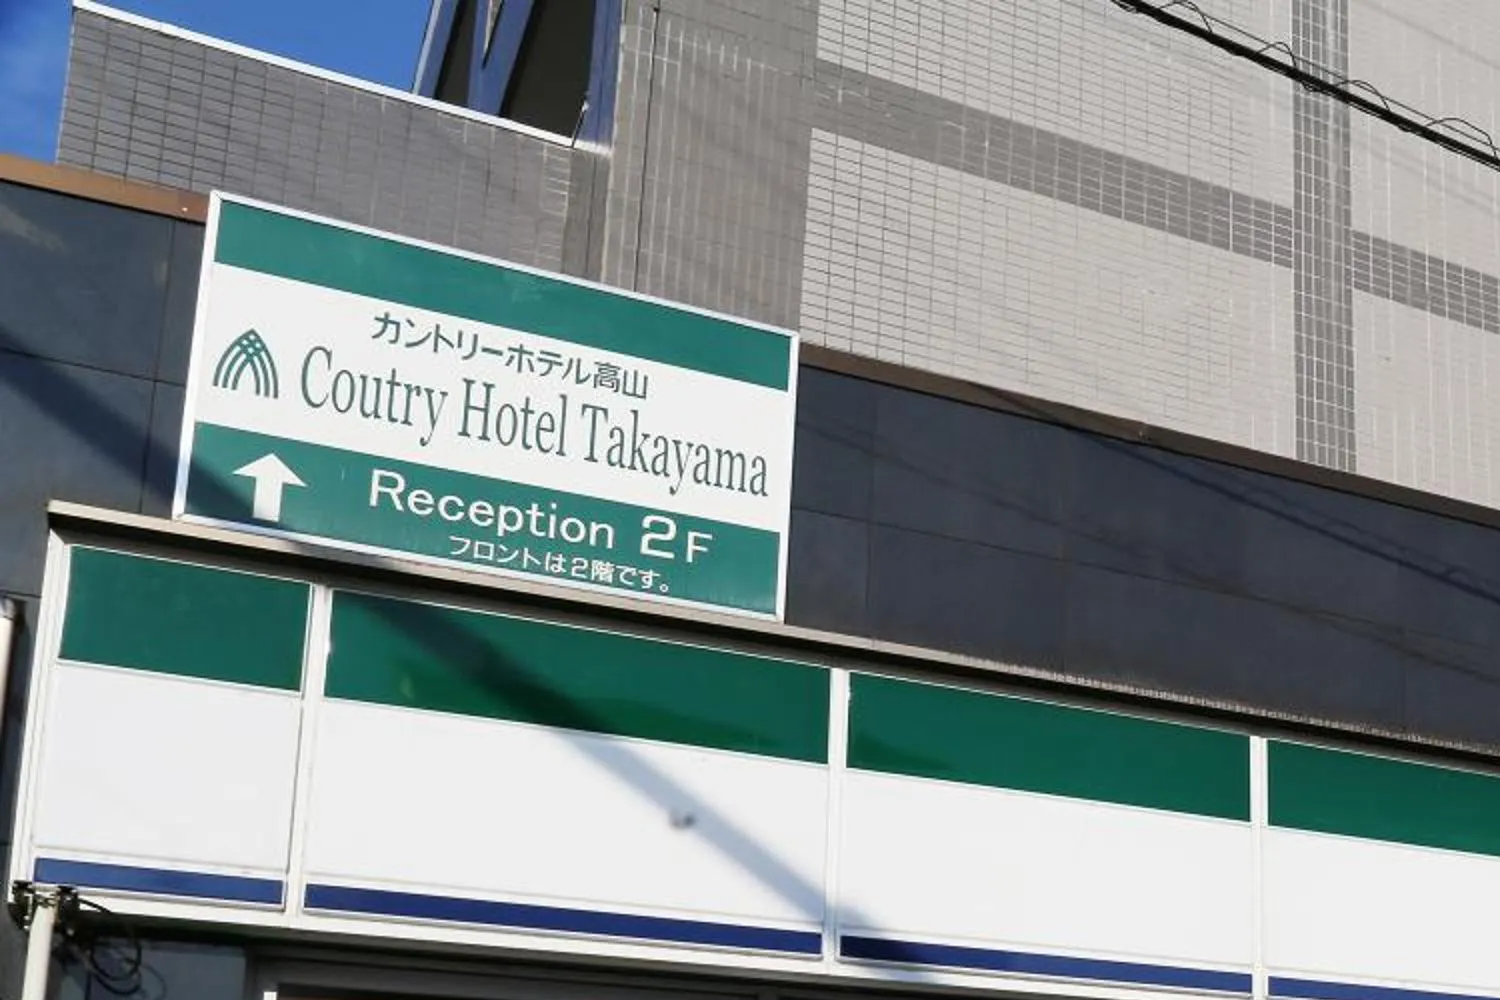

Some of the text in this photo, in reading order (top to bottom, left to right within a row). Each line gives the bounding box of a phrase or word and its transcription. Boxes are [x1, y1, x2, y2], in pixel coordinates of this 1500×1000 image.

[371, 311, 650, 400] カントリーホテル高山
[300, 346, 769, 497] Coutry Hotel Takayama
[369, 470, 614, 548] Reception
